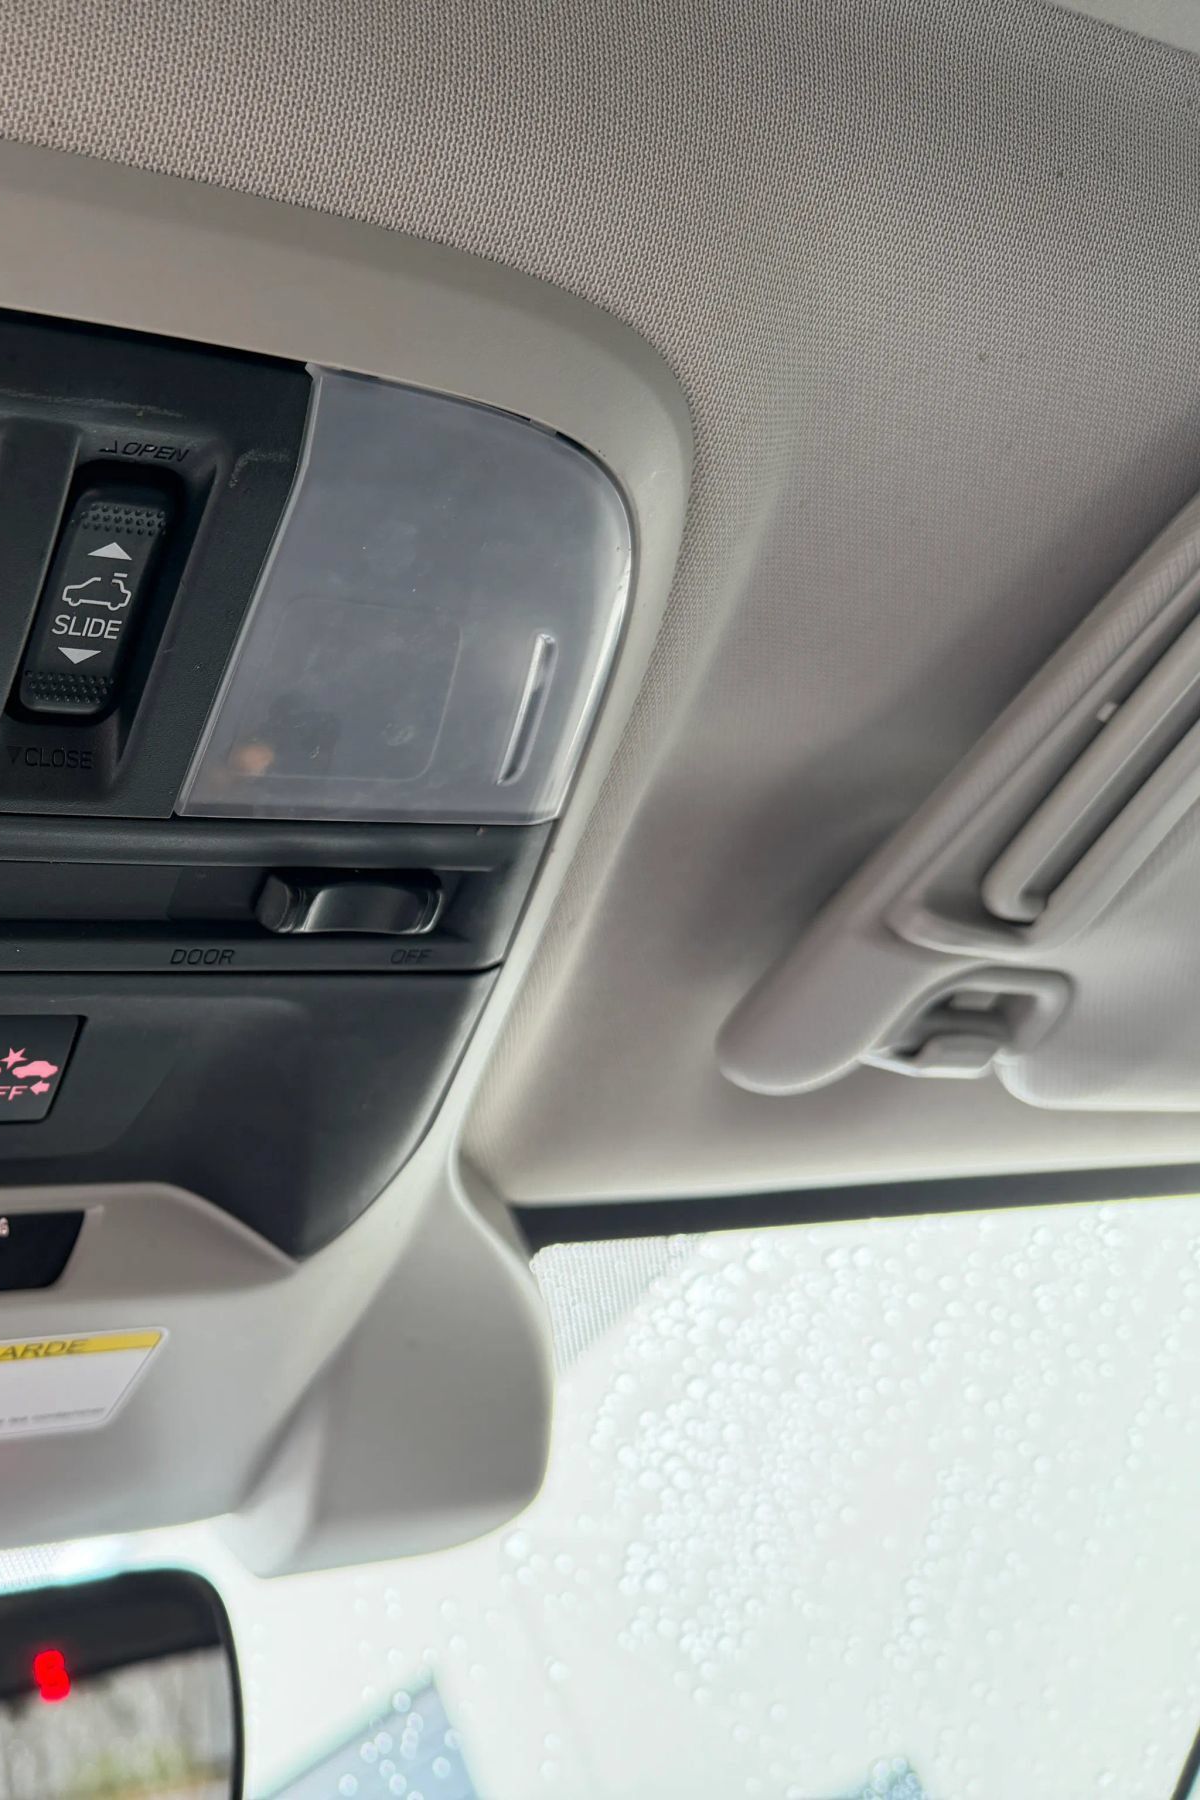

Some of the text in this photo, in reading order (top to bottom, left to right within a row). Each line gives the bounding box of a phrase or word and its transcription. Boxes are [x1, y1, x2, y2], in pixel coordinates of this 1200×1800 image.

[122, 441, 191, 463] OPEN
[51, 614, 123, 641] SLIDE
[24, 746, 93, 770] CLOSE
[169, 948, 236, 966] DOOR
[390, 948, 434, 966] OFF
